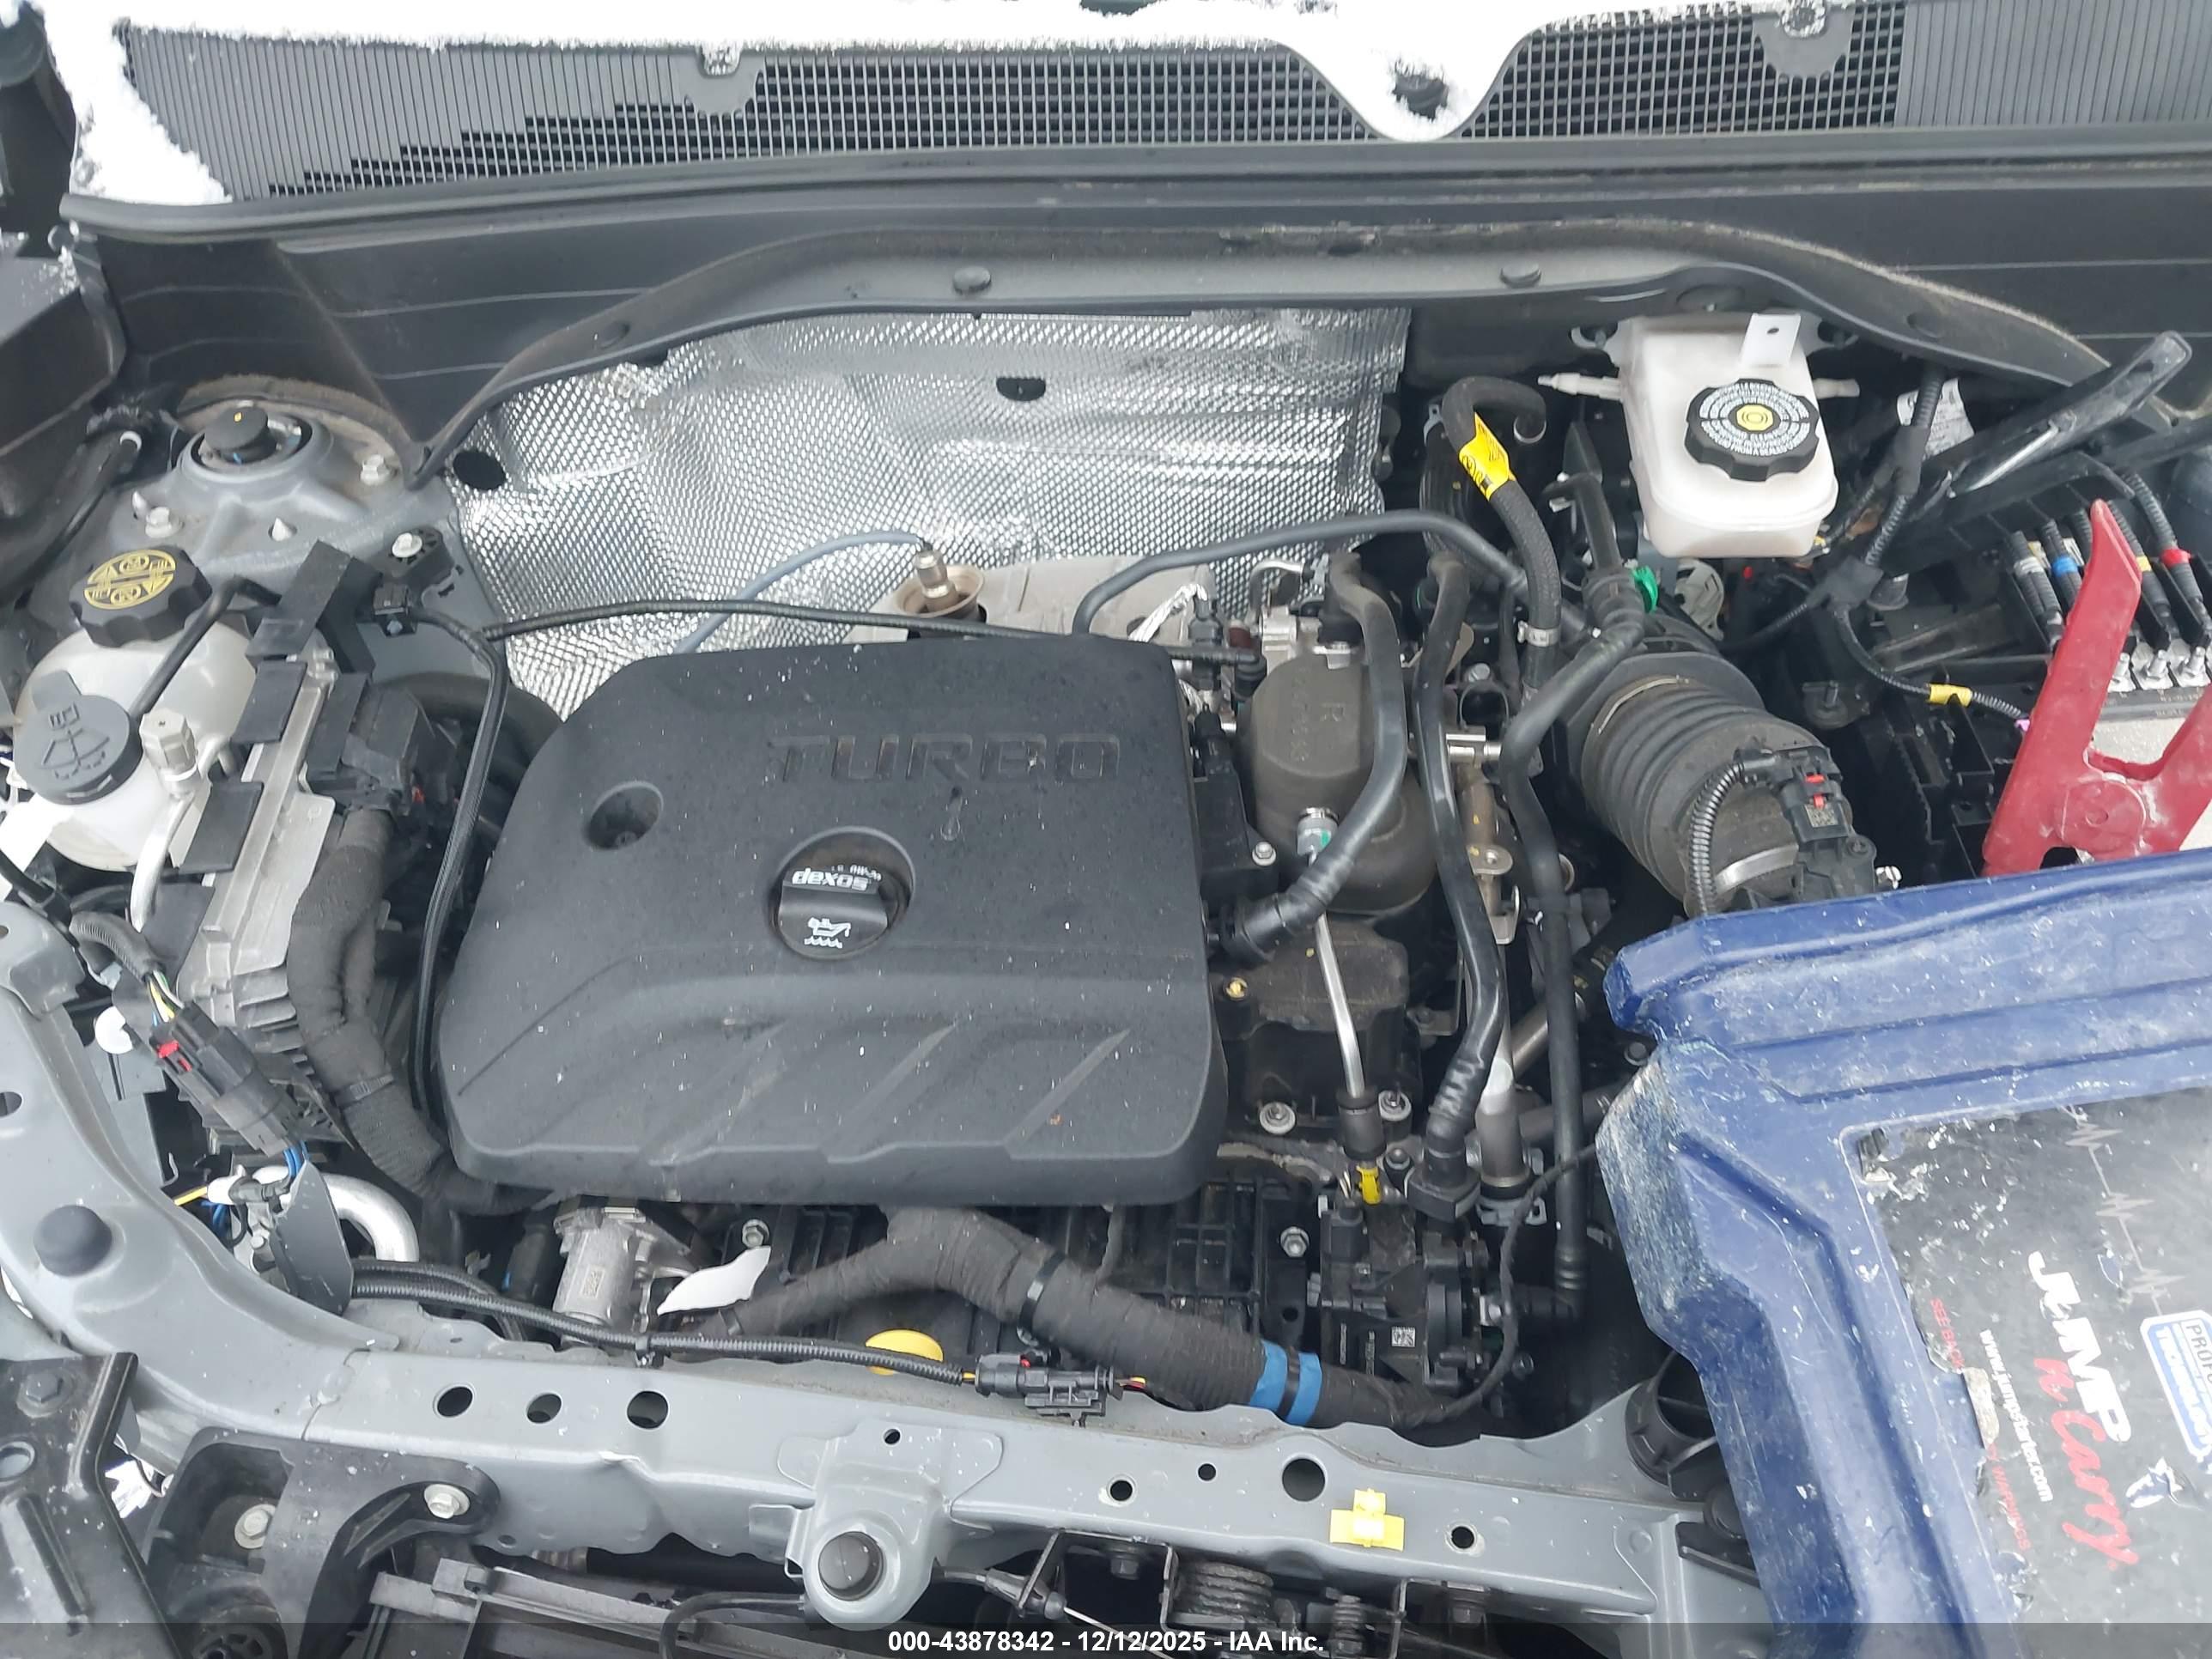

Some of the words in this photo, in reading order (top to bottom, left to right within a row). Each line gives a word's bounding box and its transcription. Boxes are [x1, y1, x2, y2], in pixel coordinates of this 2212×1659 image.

[772, 733, 1120, 782] TURBO
[792, 867, 869, 891] dexos
[1930, 1297, 1951, 1328] SEE
[1979, 1328, 2053, 1501] www.jumpstarter.com
[1992, 1466, 2032, 1550] WARNINGS
[2051, 1409, 2139, 1565] Carry
